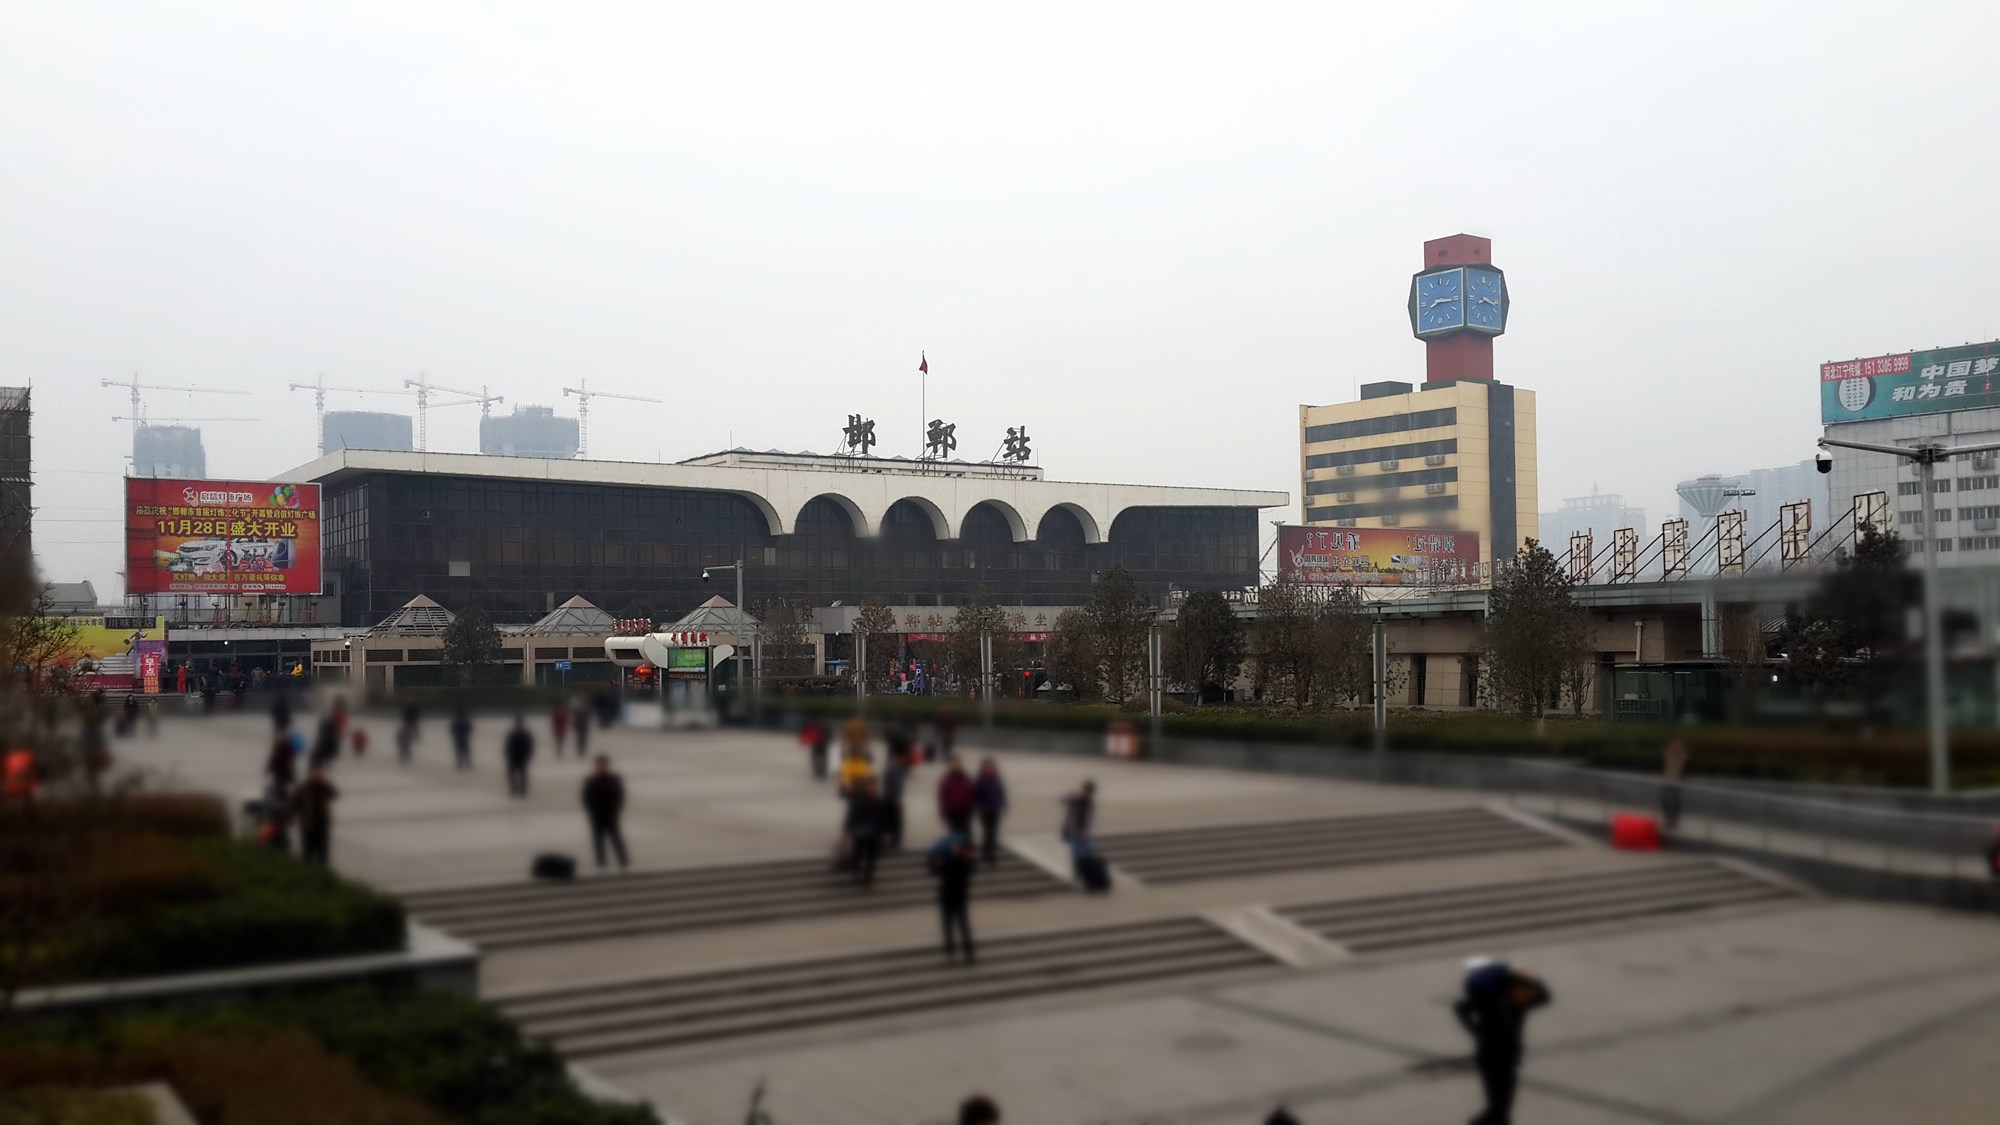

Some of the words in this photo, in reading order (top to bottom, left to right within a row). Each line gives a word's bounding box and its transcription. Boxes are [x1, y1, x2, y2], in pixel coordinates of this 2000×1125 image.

[1864, 362, 1876, 376] 151
[1920, 357, 1999, 380] 中国梦
[1891, 380, 1968, 402] 和为贵
[842, 413, 1032, 461] 邯郸站
[157, 519, 297, 537] 11月28日盛大开业
[107, 617, 155, 628] 川味饭店
[144, 658, 156, 677] 早点
